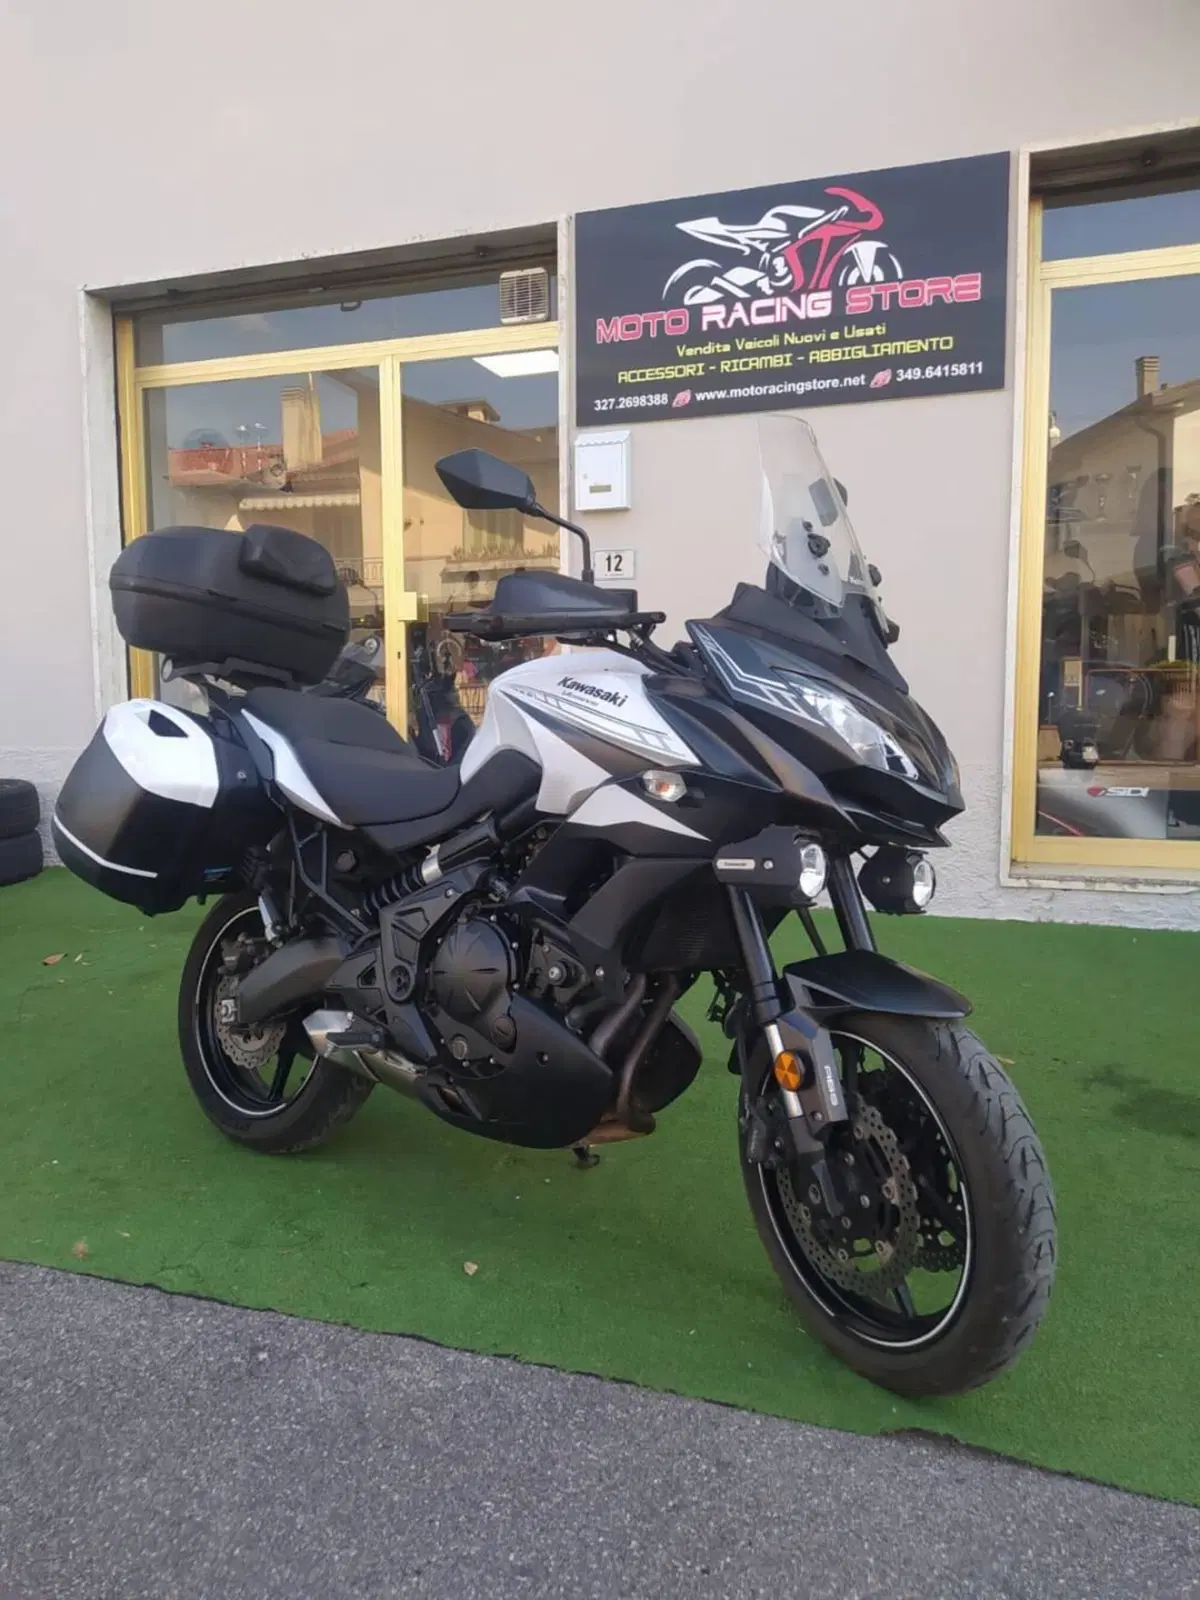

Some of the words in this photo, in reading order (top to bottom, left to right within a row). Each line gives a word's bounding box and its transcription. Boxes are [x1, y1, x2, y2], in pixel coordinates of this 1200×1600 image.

[596, 308, 690, 344] MOTO
[701, 290, 832, 332] RACING
[845, 272, 982, 315] STORE
[617, 362, 706, 384] ACCESSORI
[720, 353, 794, 373] RICAMBI
[808, 336, 955, 364] ABBIGLIAMENTO
[676, 343, 731, 357] Vendita
[735, 333, 781, 351] Veicoli
[783, 329, 827, 344] Nuovi
[829, 331, 840, 341] e
[843, 322, 887, 339] Usati
[593, 393, 669, 412] 327.2698388
[694, 373, 867, 401] www.motoracingstore.net
[895, 361, 984, 382] 349.6415811
[605, 554, 623, 572] 12
[557, 676, 629, 708] Kawasaki
